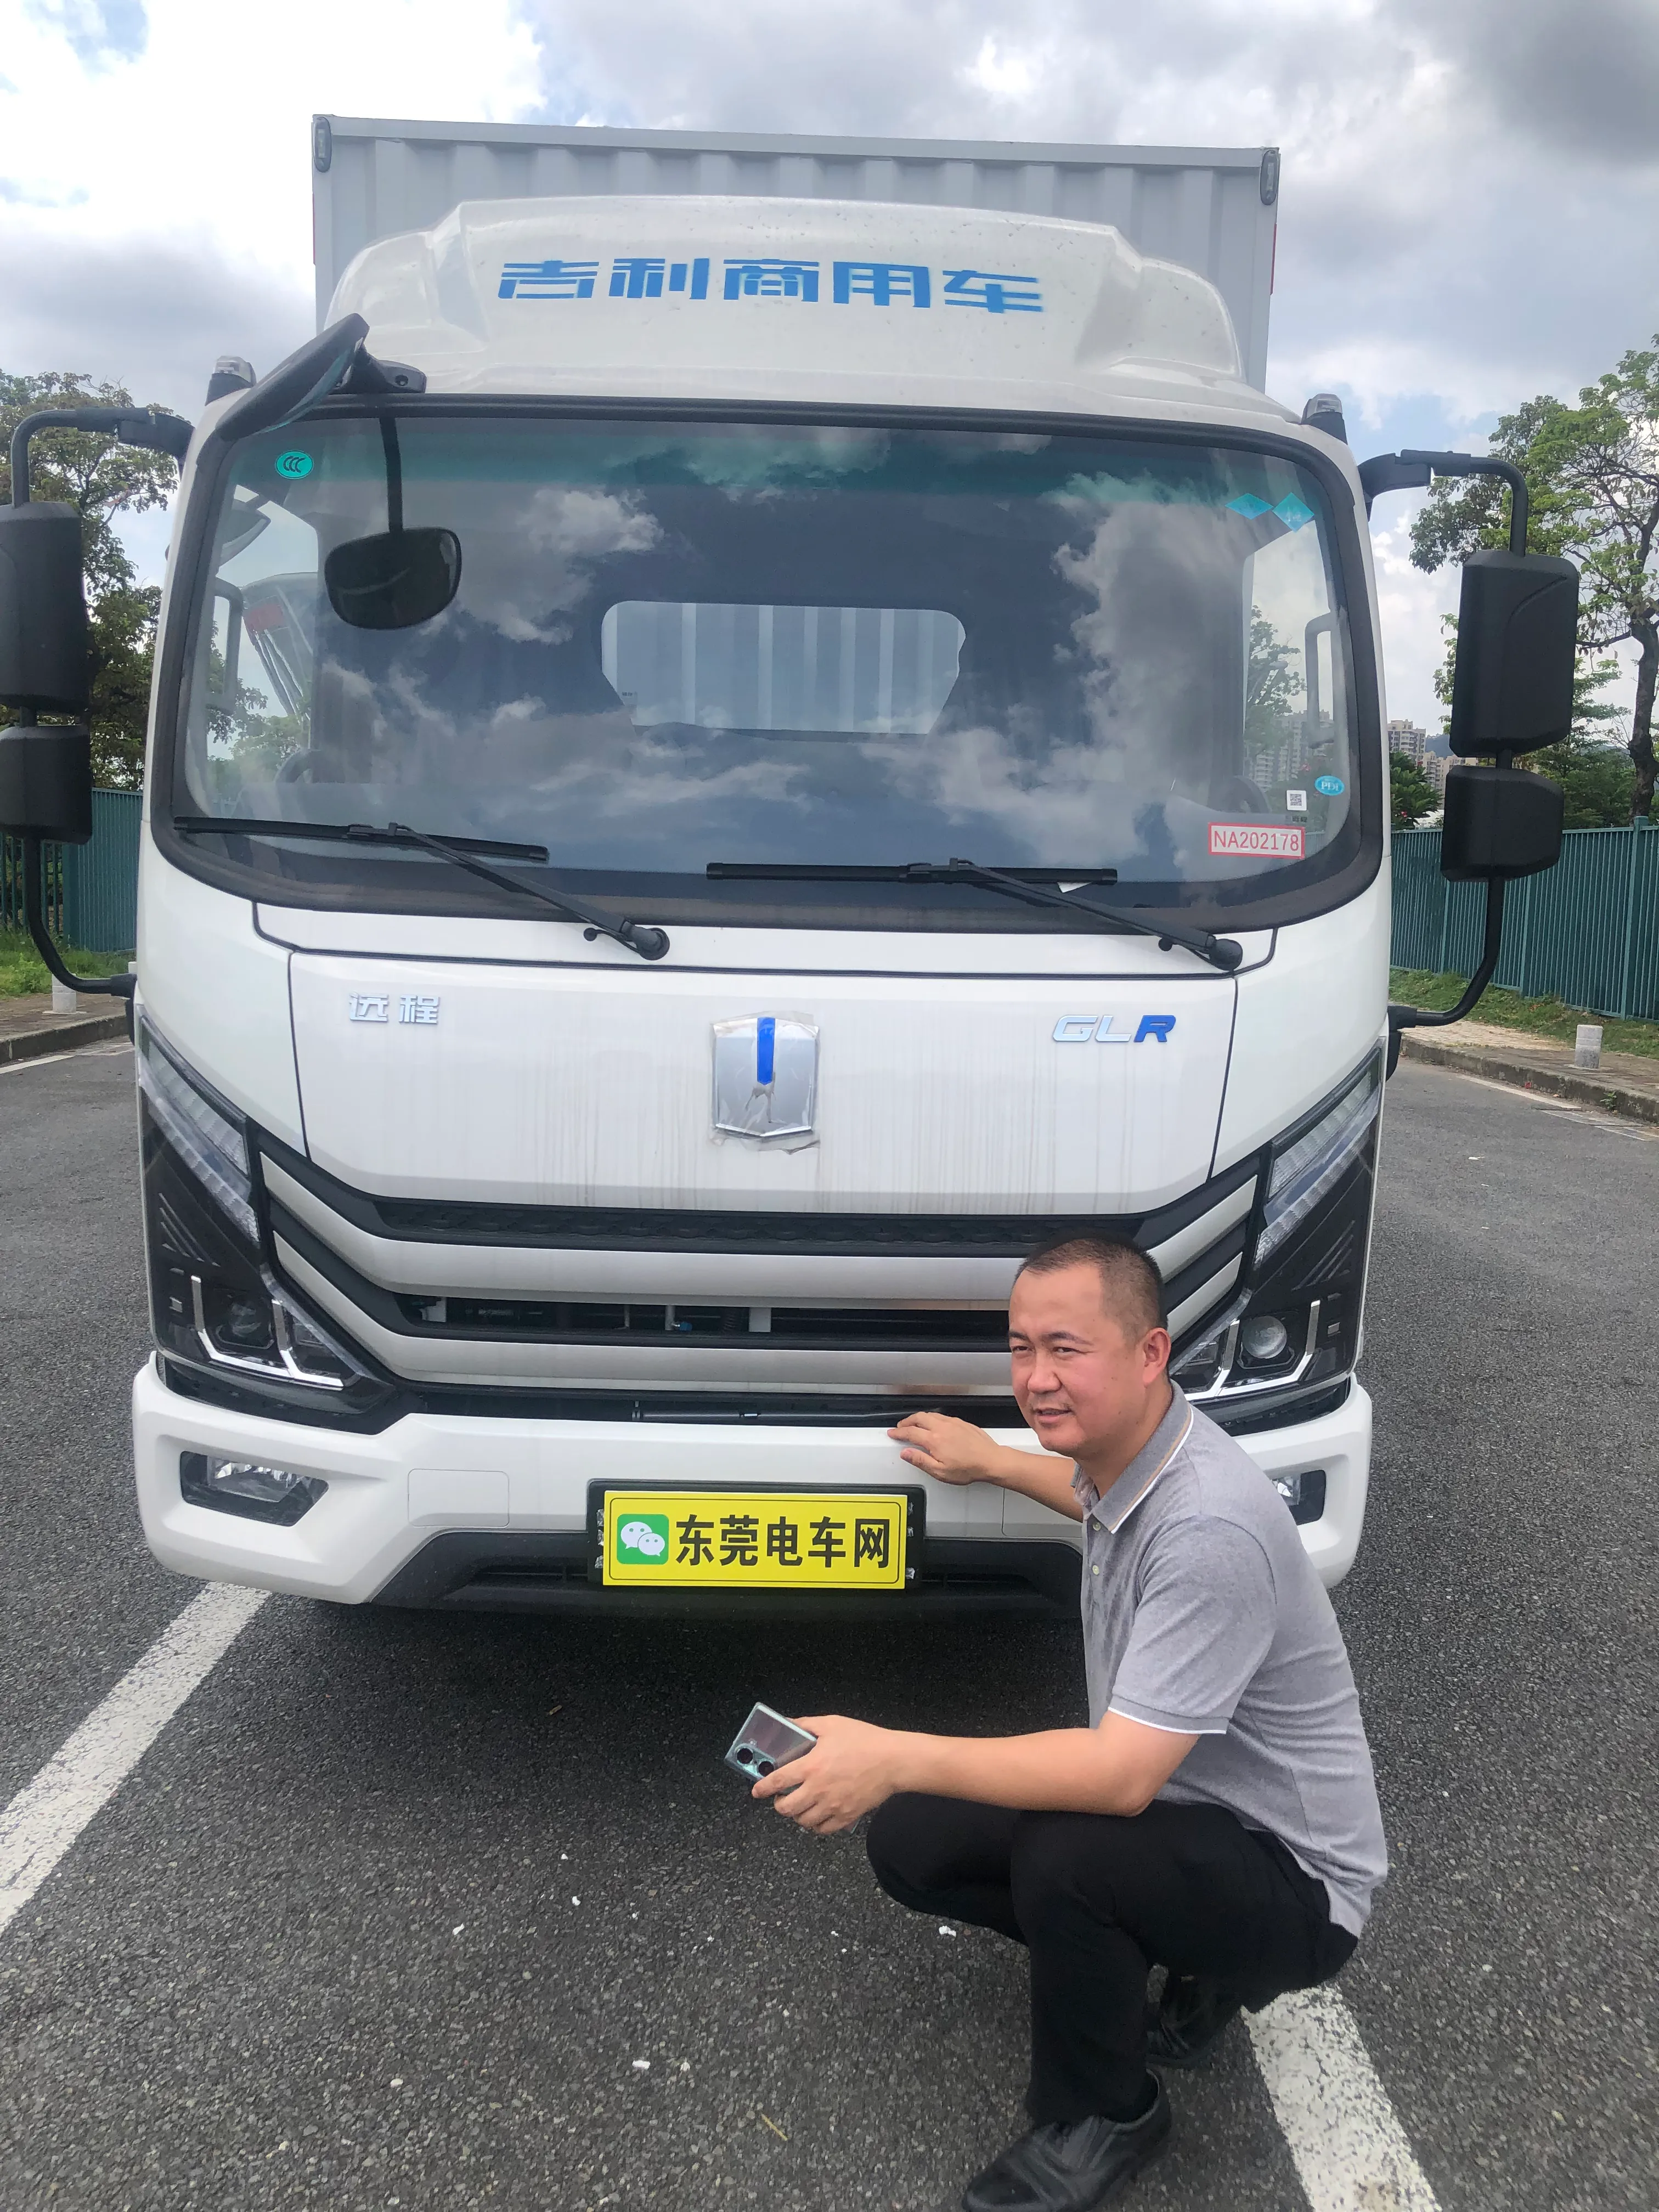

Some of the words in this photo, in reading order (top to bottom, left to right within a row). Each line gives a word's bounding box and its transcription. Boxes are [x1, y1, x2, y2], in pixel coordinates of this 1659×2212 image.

[498, 258, 1043, 314] 吉利商用车
[1214, 830, 1299, 851] NA202178
[348, 991, 441, 1025] 远程
[1052, 1014, 1176, 1042] GLR
[675, 1514, 890, 1569] 东莞电车网
